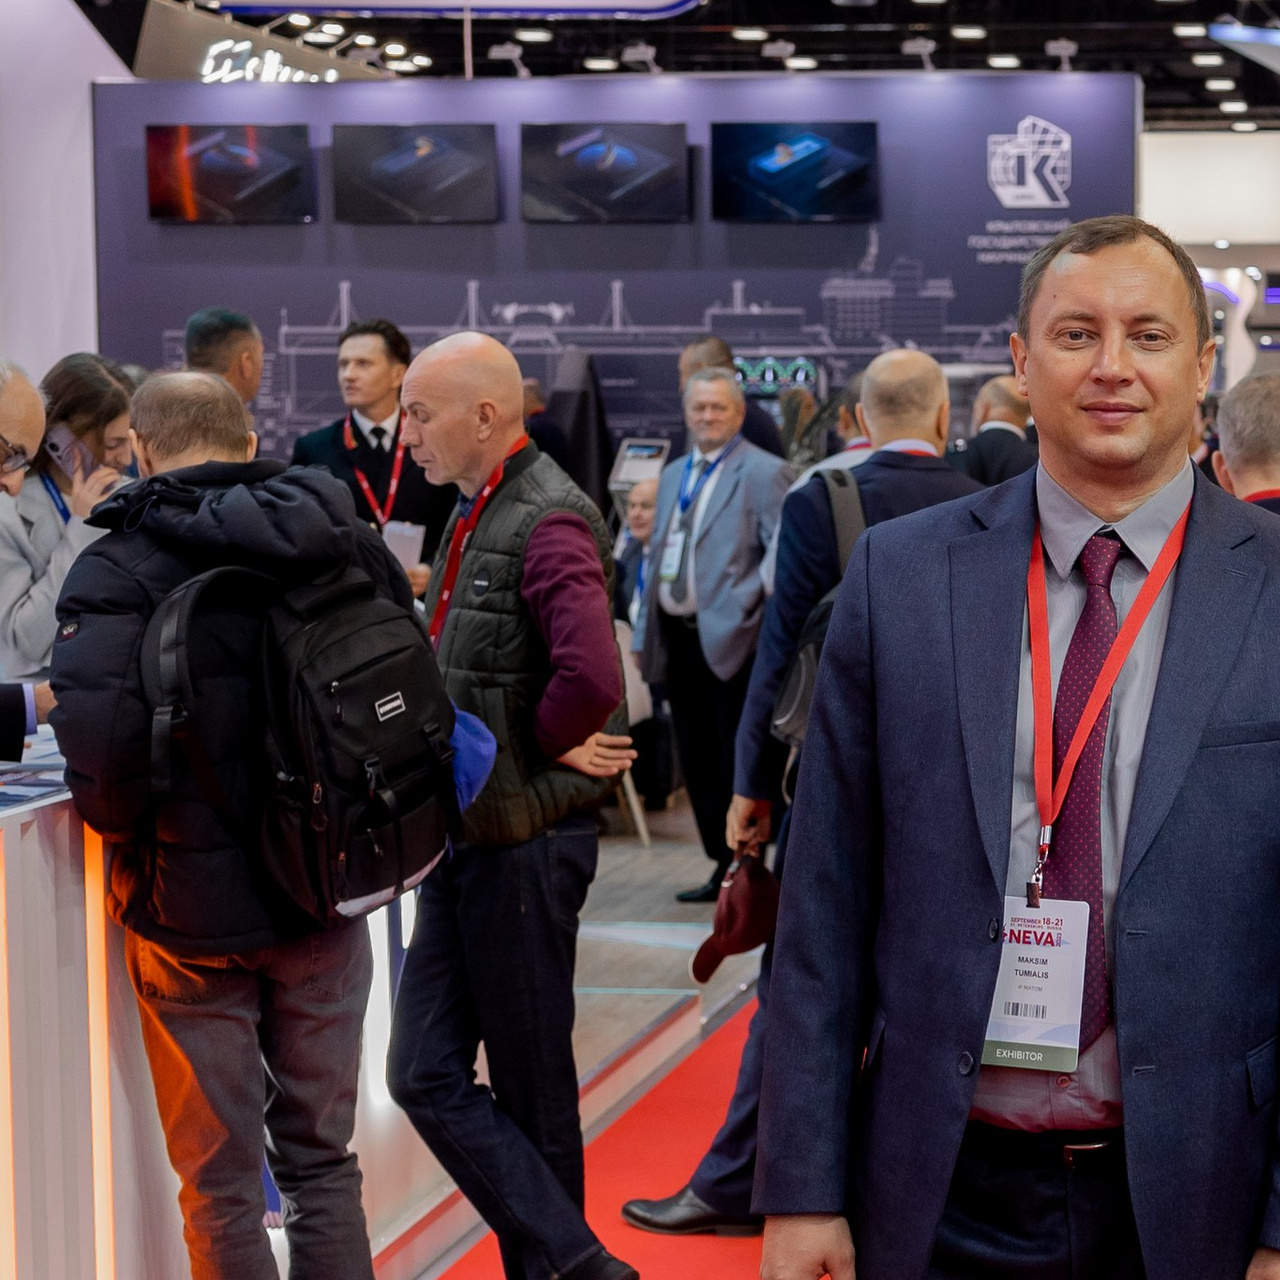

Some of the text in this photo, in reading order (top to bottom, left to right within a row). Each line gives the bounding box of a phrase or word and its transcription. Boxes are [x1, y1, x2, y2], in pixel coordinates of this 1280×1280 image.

[1008, 929, 1055, 947] NEVA
[1017, 956, 1048, 966] MAKSIM
[1014, 969, 1049, 979] TUMIALIS
[996, 1048, 1043, 1062] EXHIBITOR
